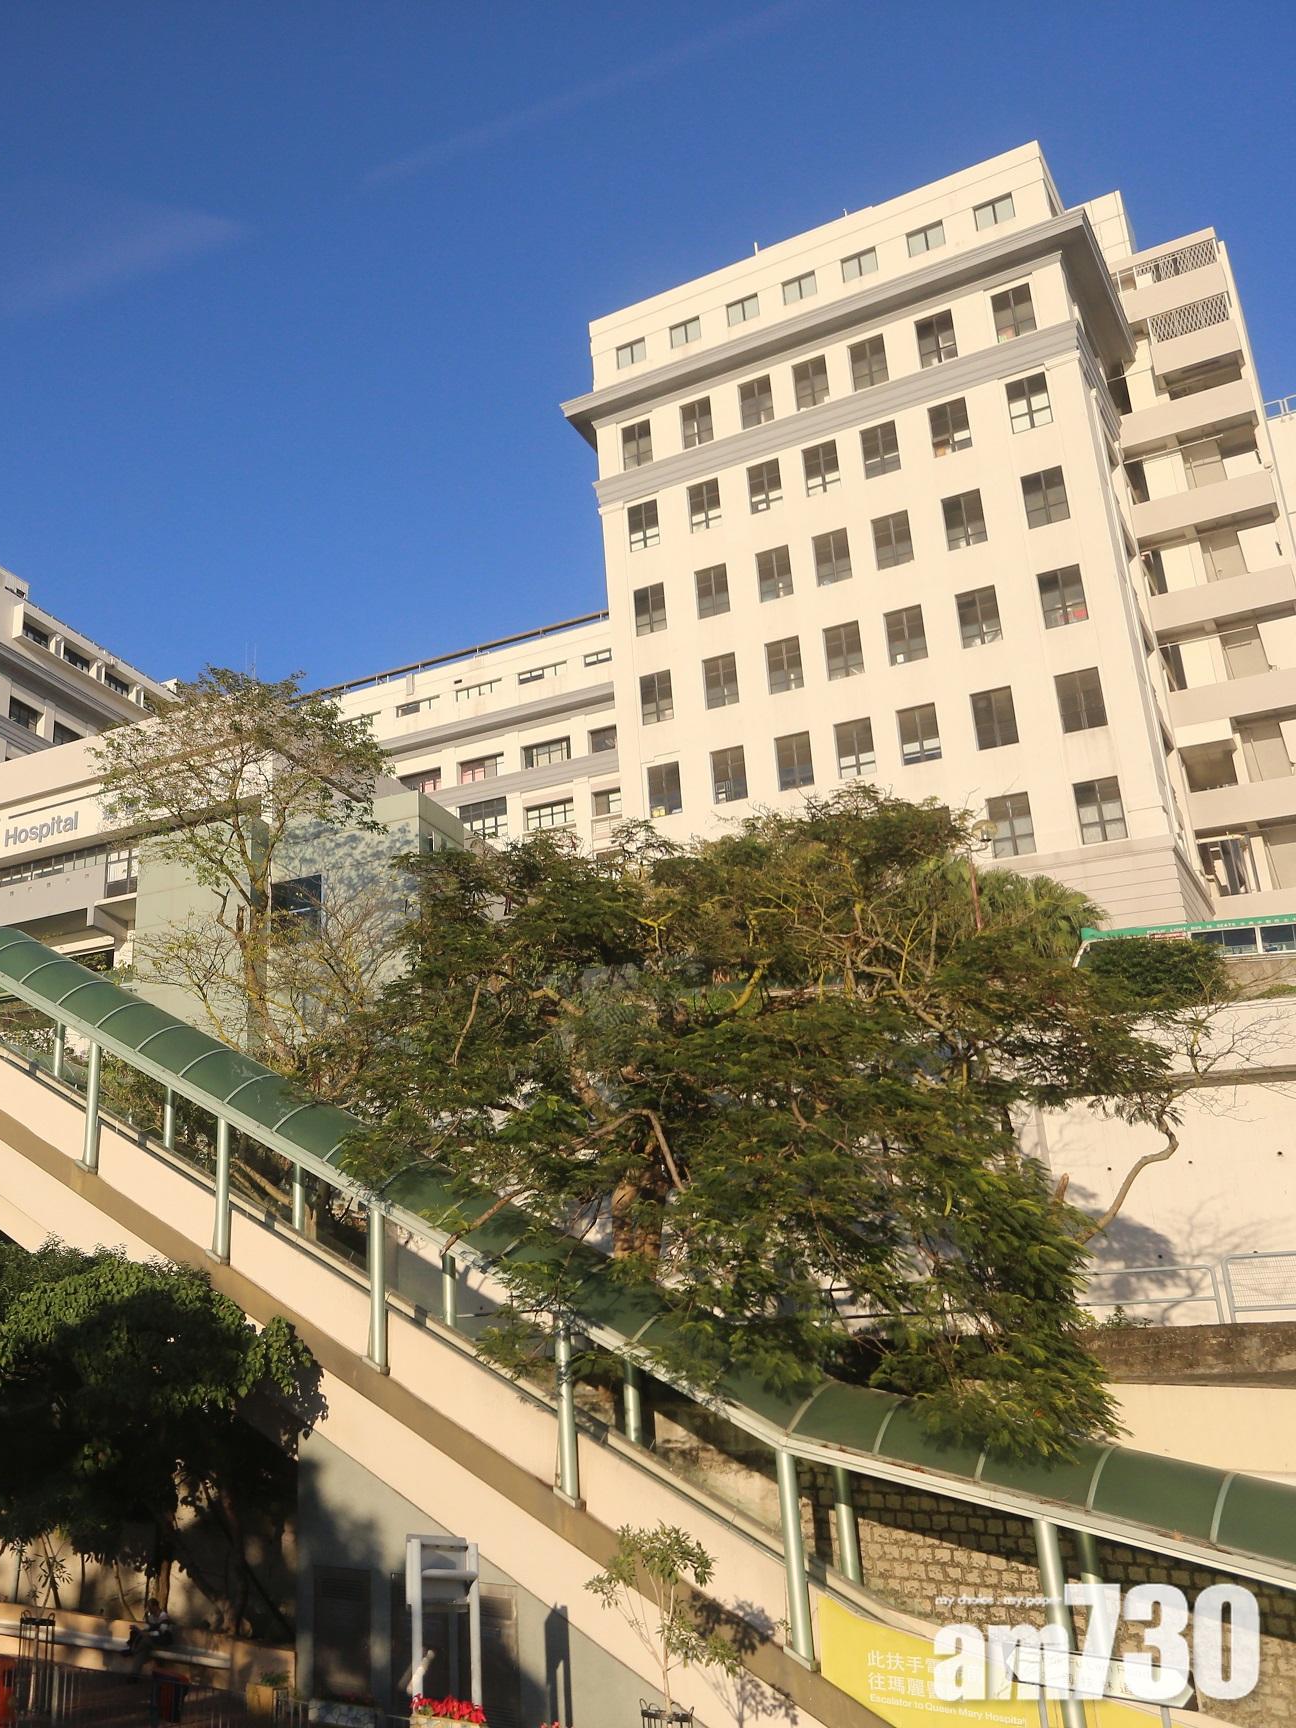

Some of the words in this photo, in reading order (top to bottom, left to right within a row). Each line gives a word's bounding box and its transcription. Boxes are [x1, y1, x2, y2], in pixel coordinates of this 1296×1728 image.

[4, 811, 80, 847] Hospital
[870, 1693, 913, 1708] Escalator
[914, 1700, 924, 1710] to
[925, 1702, 958, 1715] Queen
[959, 1707, 984, 1720] Mary
[985, 1711, 1026, 1726] Hospital
